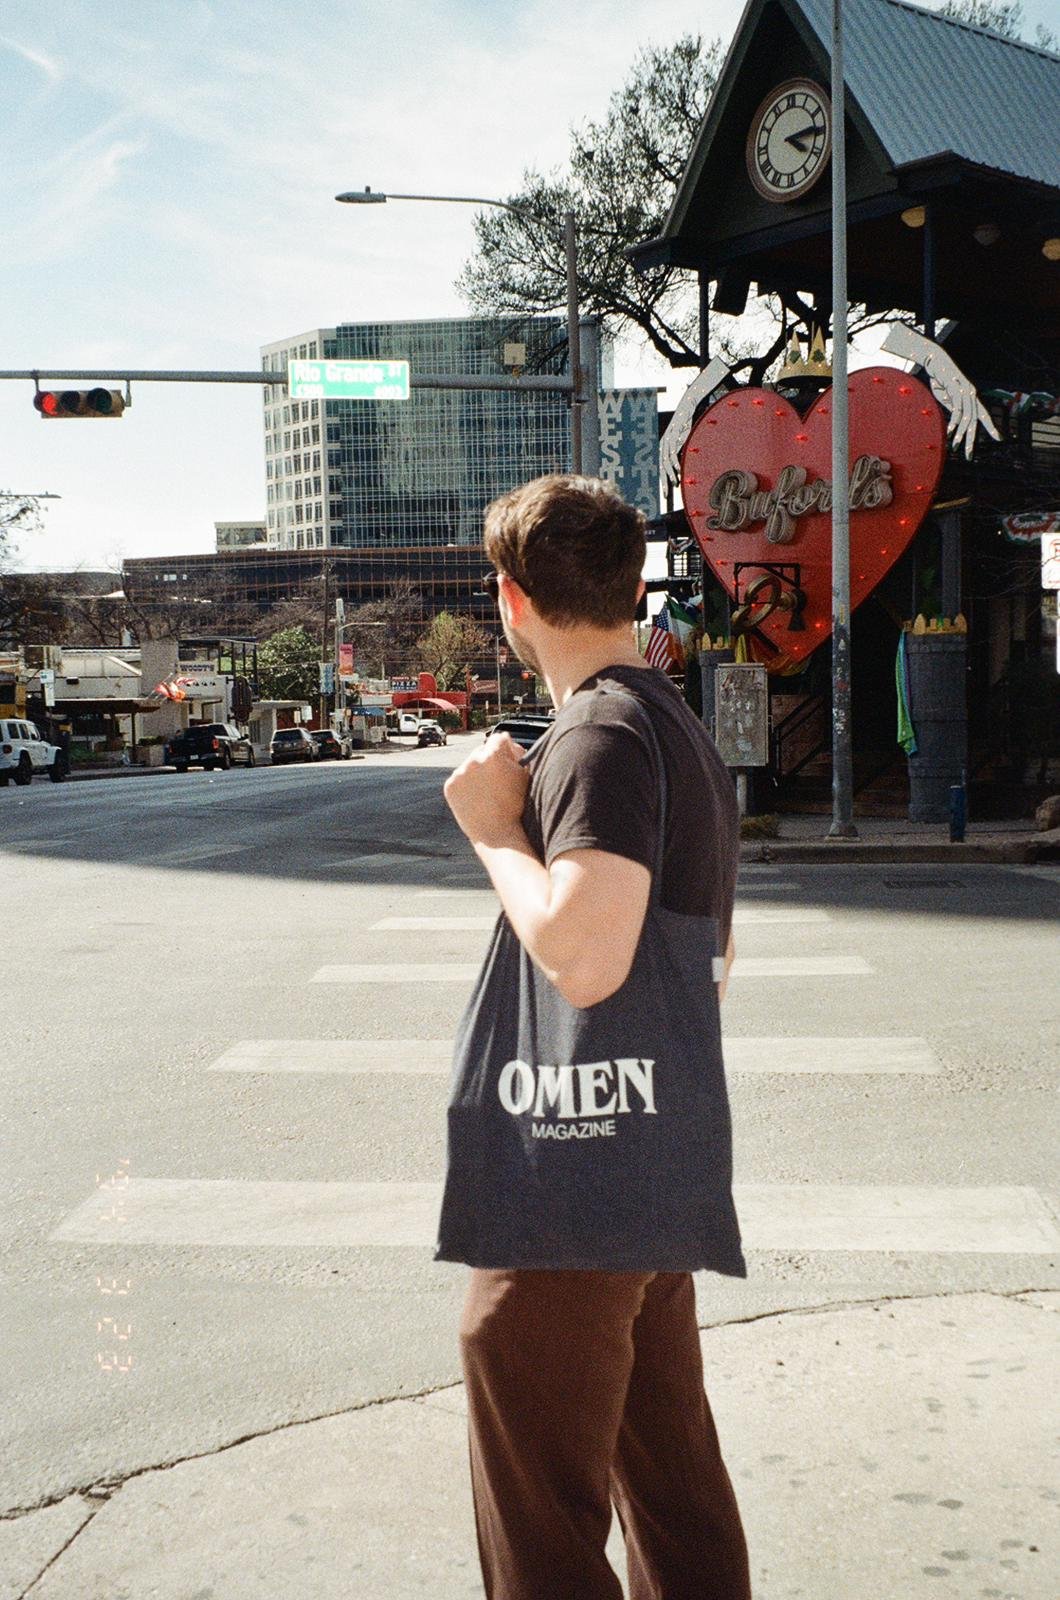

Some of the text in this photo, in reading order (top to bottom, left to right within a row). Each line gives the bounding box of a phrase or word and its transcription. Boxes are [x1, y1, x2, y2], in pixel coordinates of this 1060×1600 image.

[294, 363, 321, 382] Rio
[325, 363, 385, 383] Grande
[498, 1057, 657, 1118] OMEN
[531, 1119, 616, 1140] MAGAZINE
